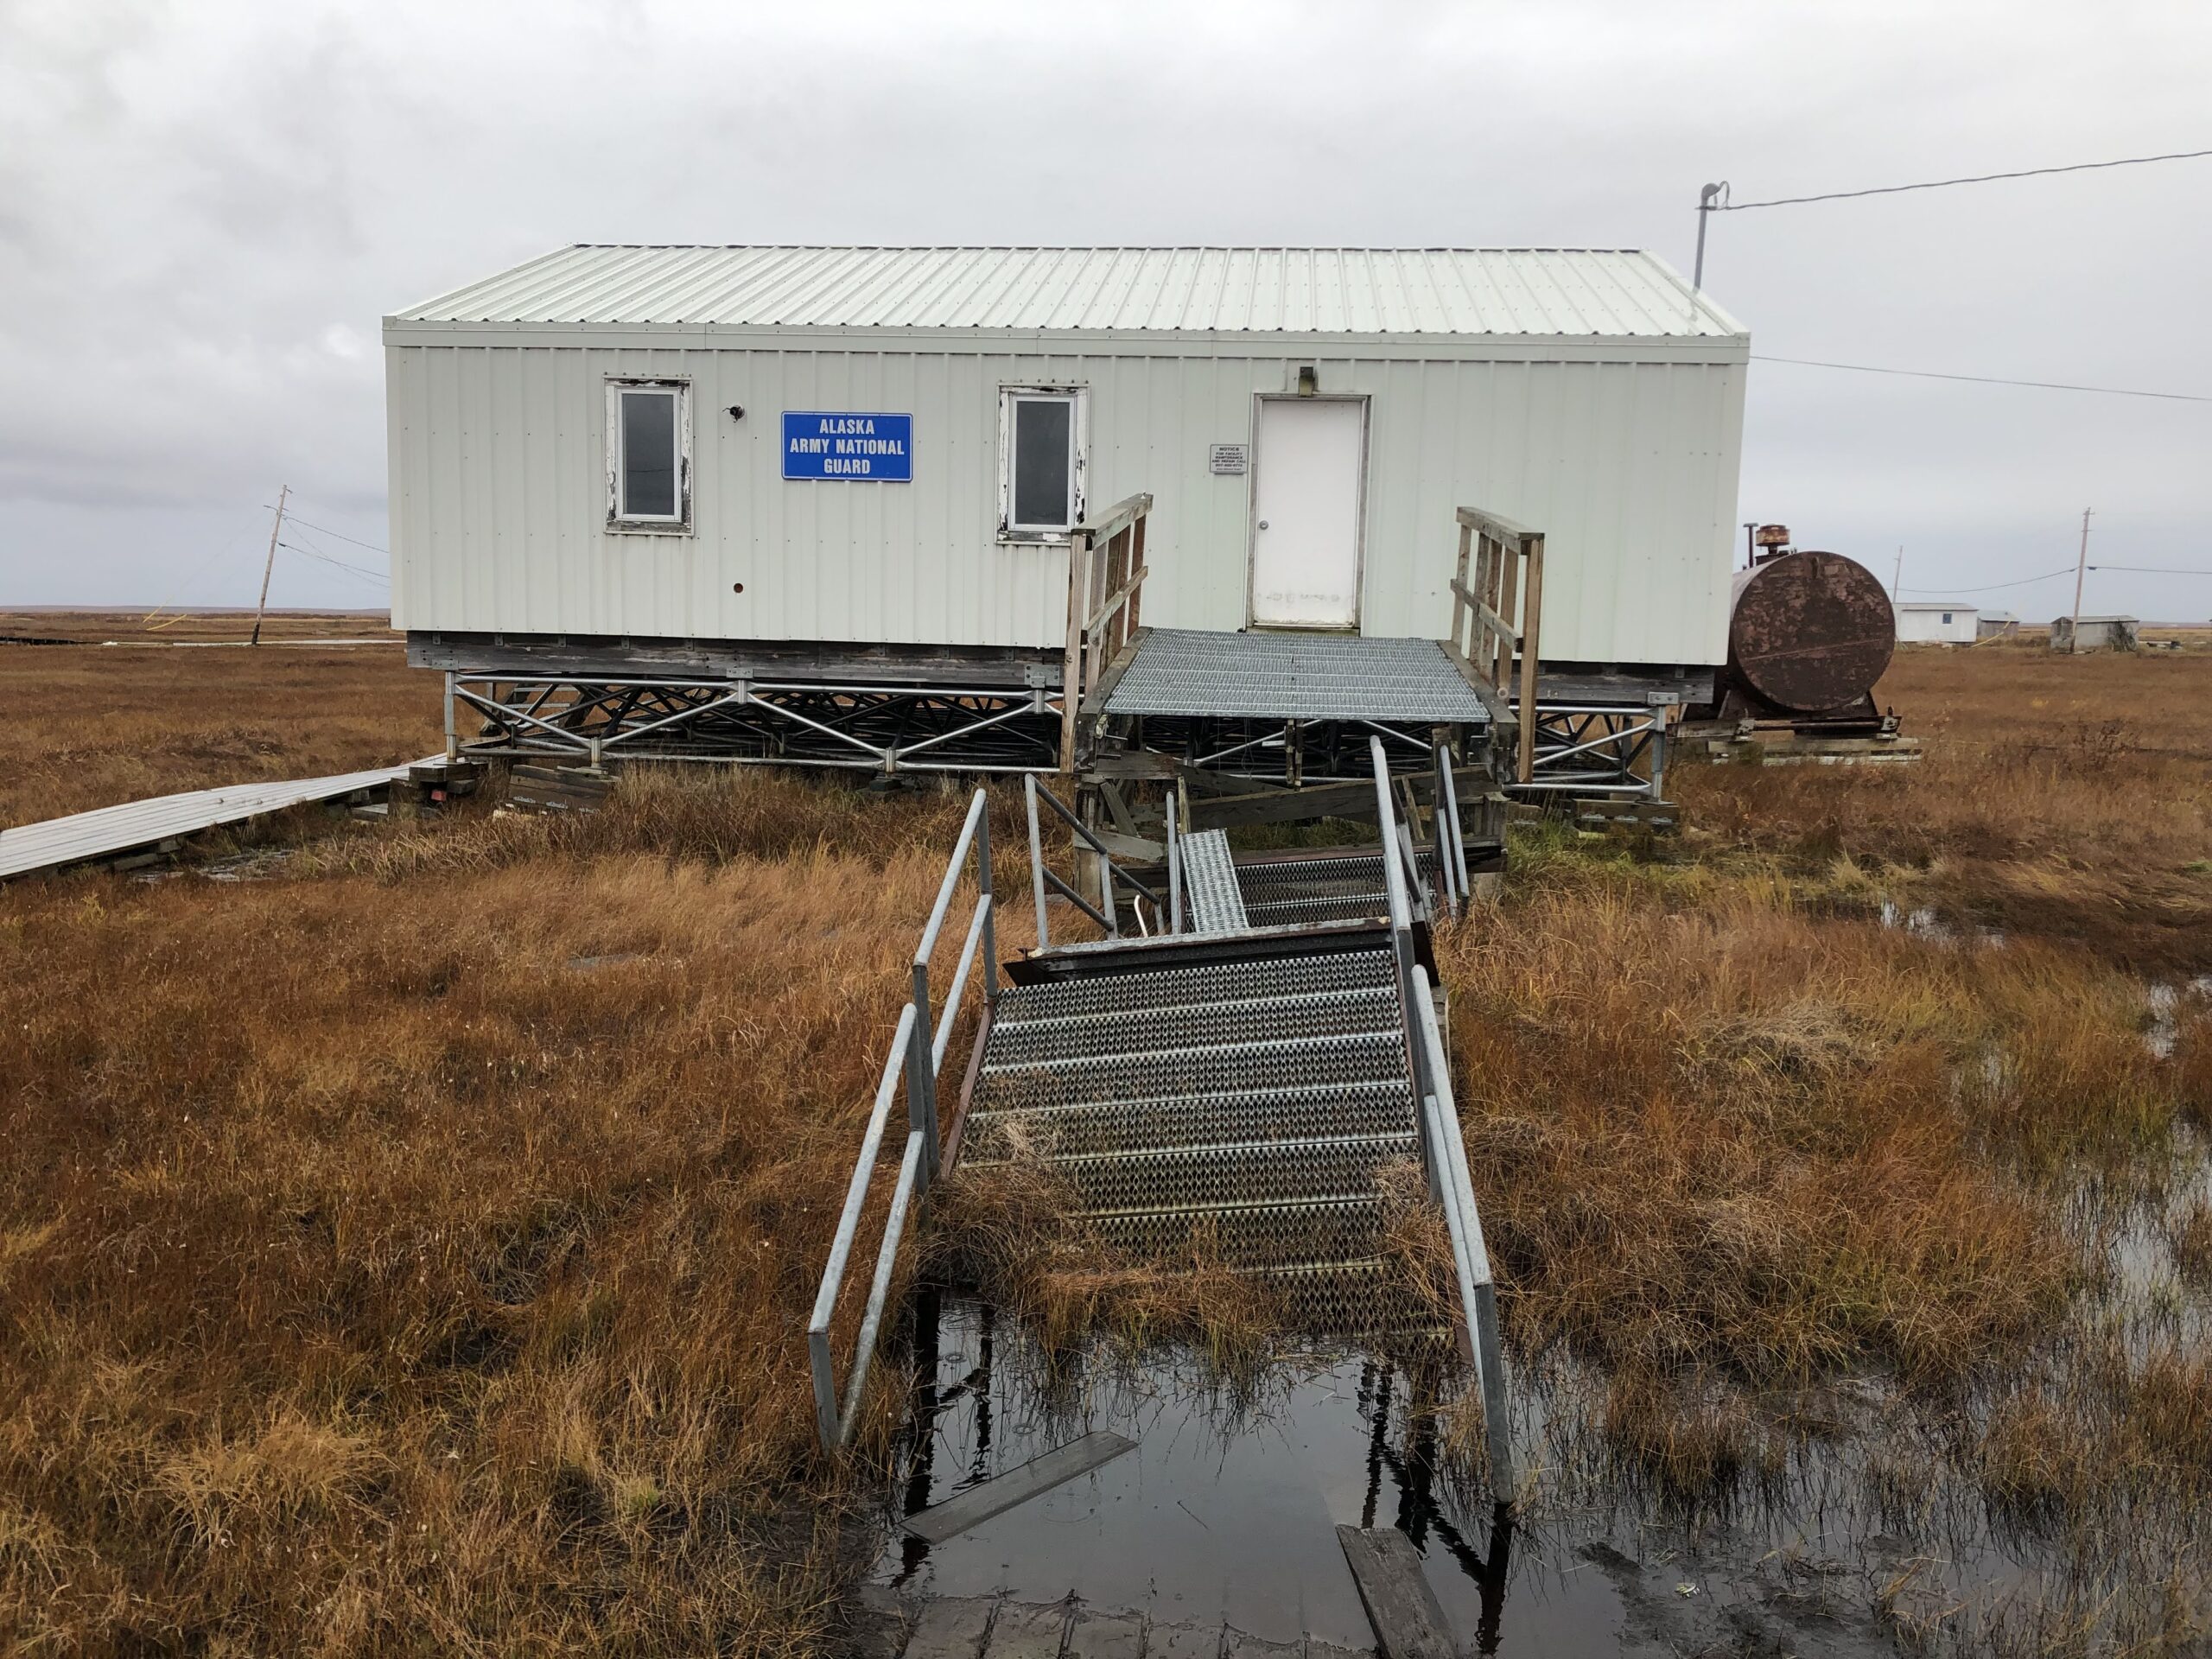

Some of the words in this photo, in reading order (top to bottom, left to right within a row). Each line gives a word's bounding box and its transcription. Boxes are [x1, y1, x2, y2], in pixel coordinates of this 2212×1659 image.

[819, 419, 875, 435] ALASKA
[790, 438, 830, 454] ARMY
[836, 439, 905, 454] NATIONAL
[823, 458, 871, 474] GUARD
